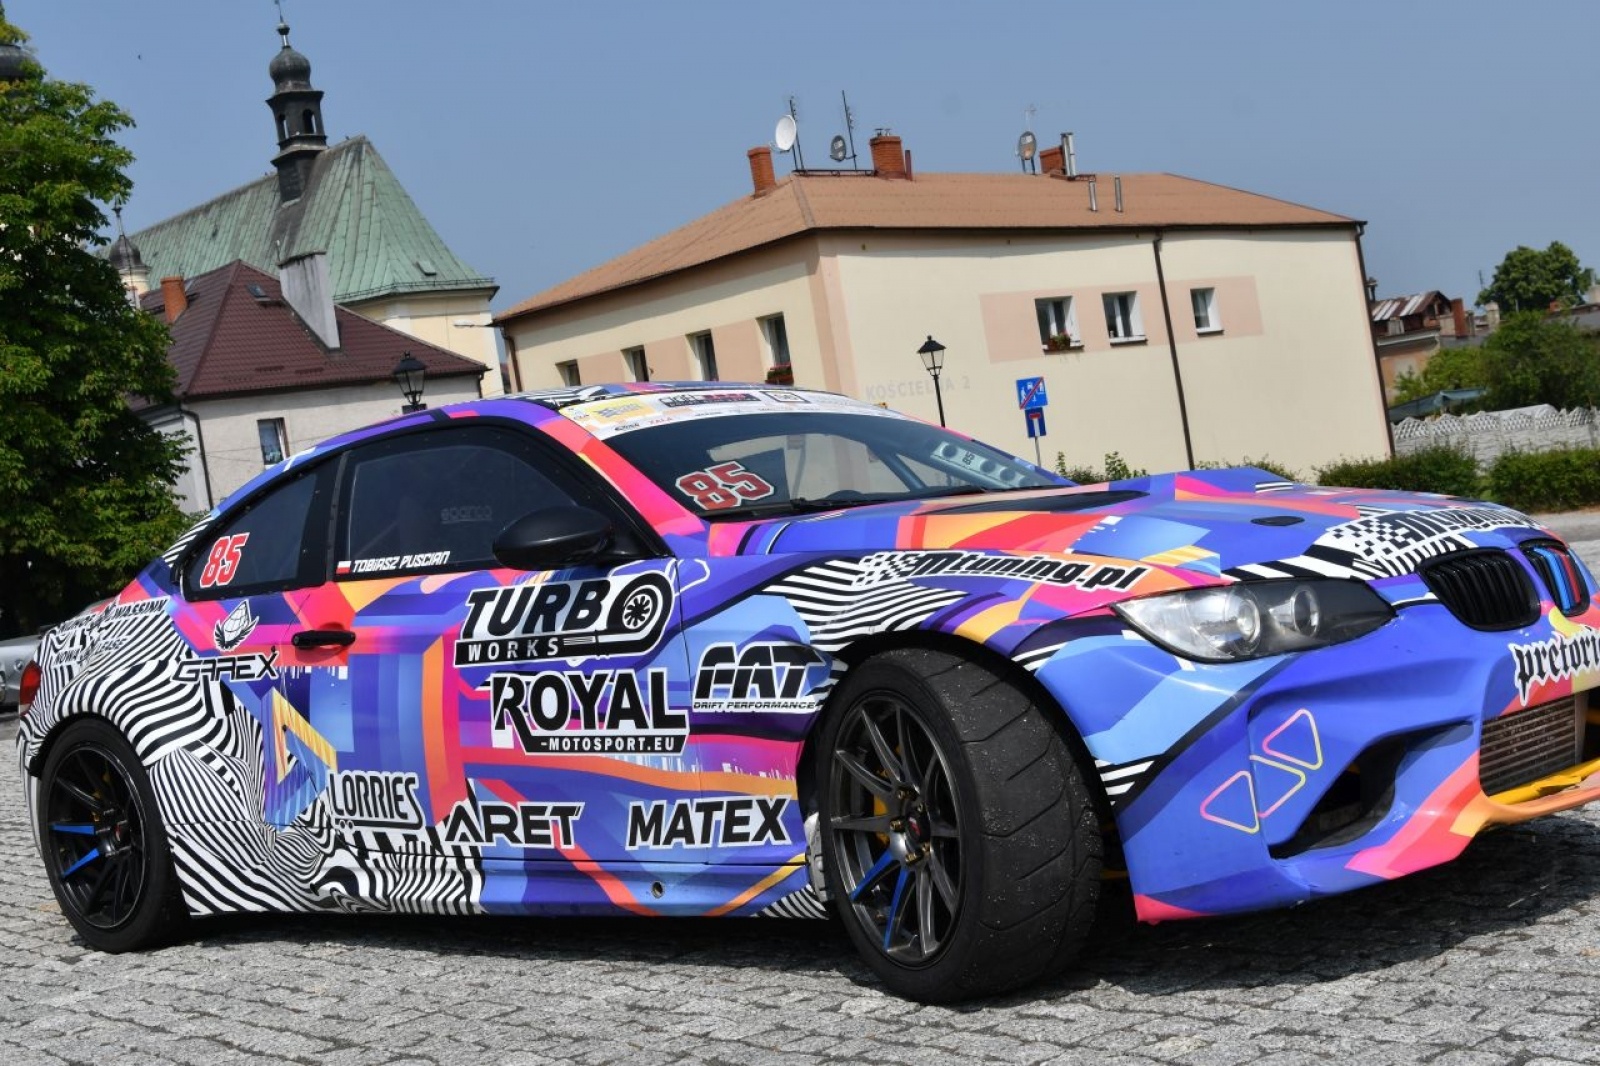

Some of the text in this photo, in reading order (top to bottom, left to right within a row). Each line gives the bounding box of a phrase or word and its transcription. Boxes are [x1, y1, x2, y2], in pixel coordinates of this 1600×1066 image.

[962, 376, 971, 389] 2
[675, 461, 775, 511] 85
[200, 532, 250, 588] 85
[352, 555, 400, 573] TOBIASZ
[467, 637, 559, 662] WORKS
[695, 645, 825, 700] FAT
[493, 670, 687, 742] ROYAL
[694, 701, 816, 709] DRIFT PERFORMANCE
[328, 772, 423, 830] LORRIES
[445, 804, 581, 846] ARET
[628, 798, 787, 847] MATEX
